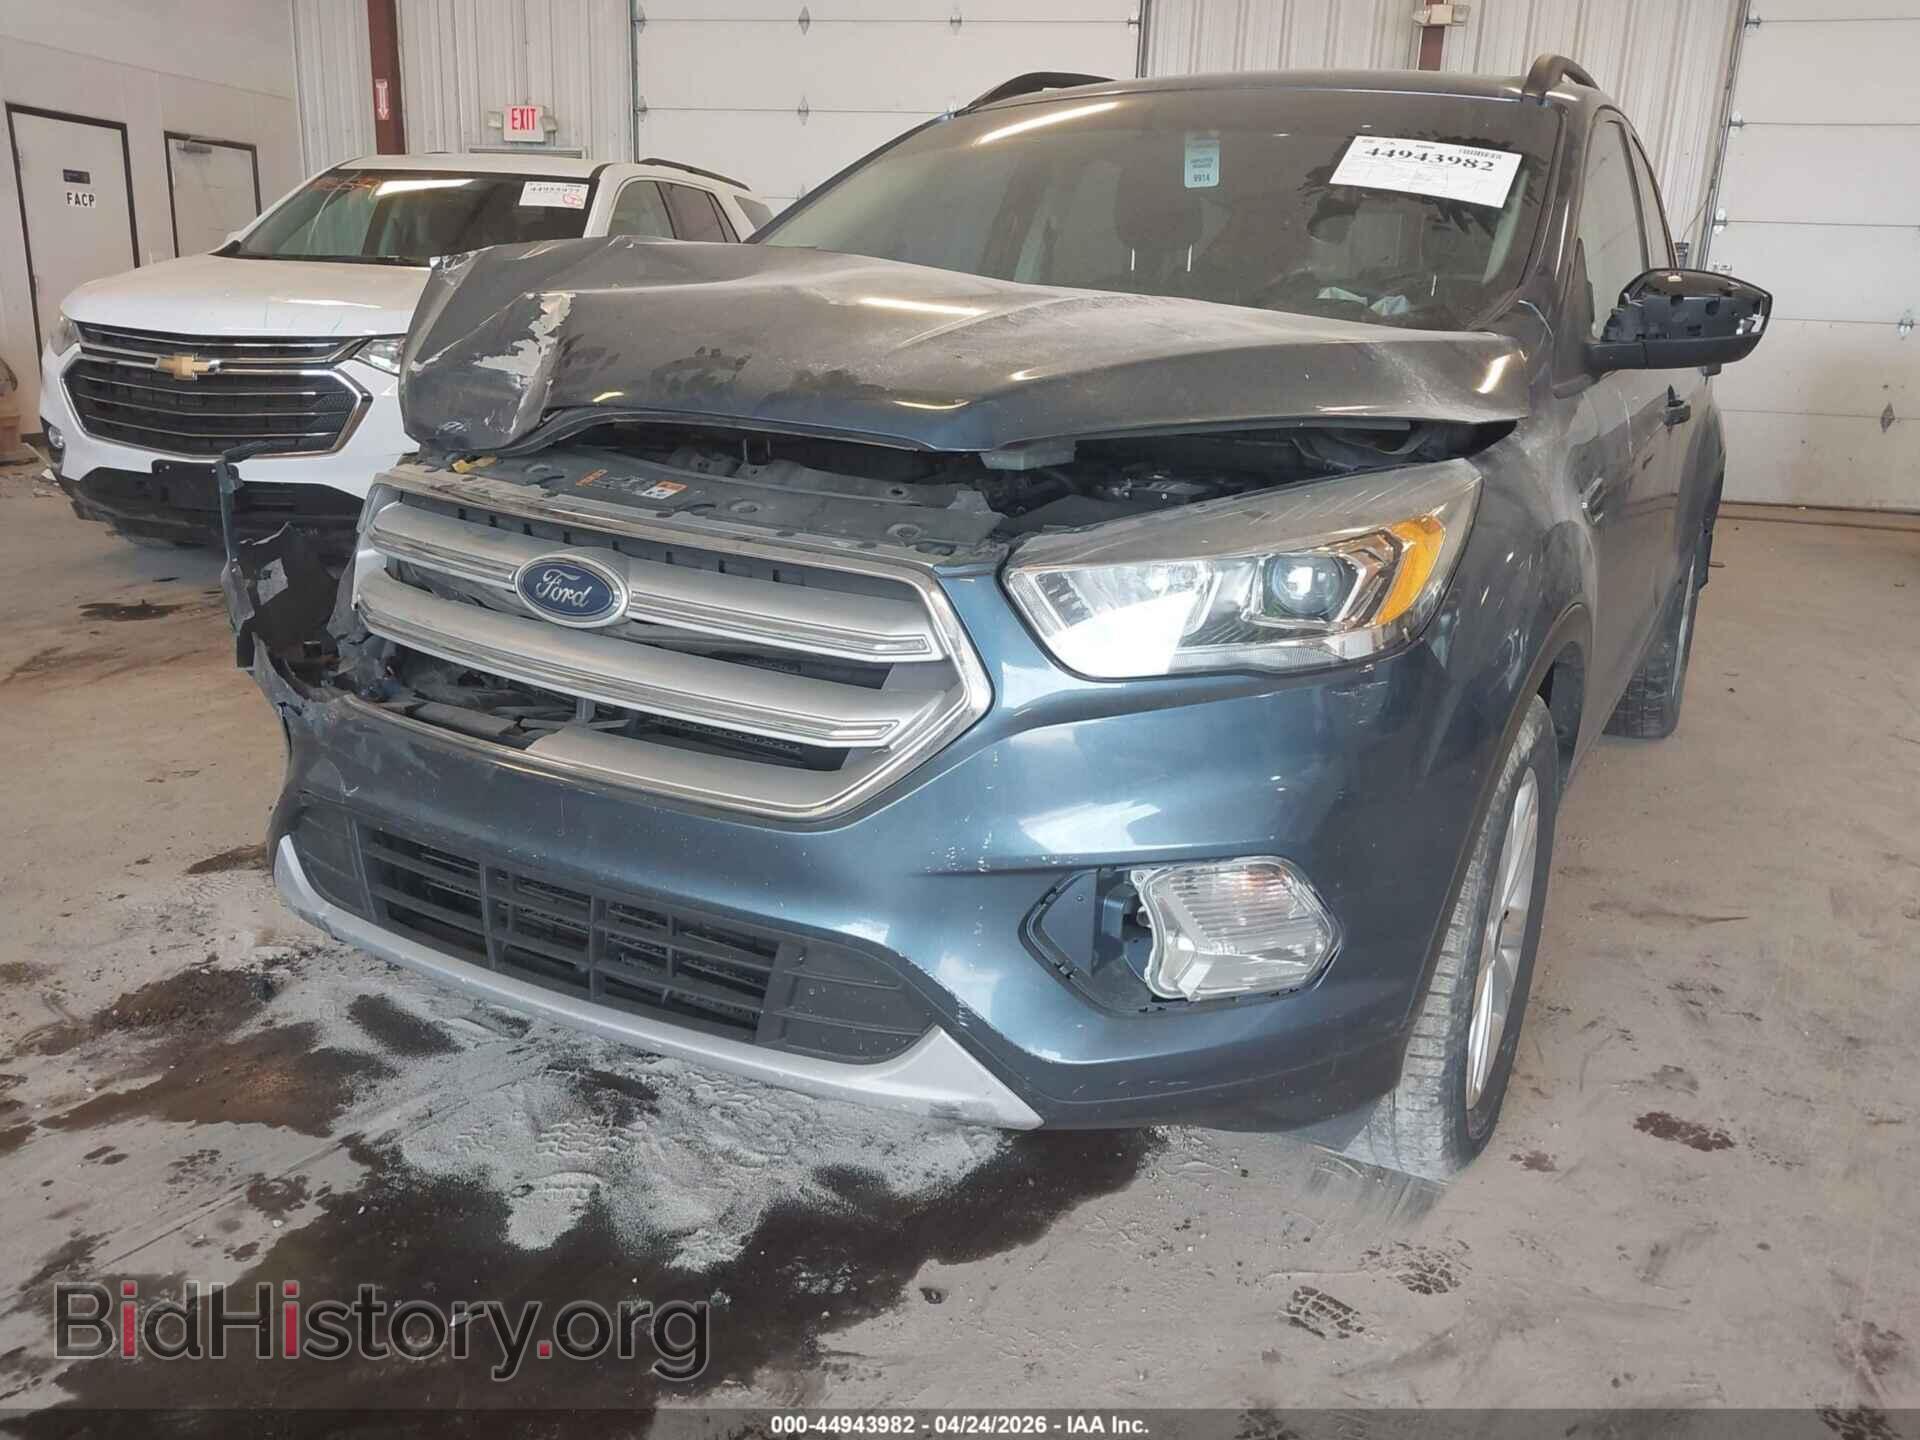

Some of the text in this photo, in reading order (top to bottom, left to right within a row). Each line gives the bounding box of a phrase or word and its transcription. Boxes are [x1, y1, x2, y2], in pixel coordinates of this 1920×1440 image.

[511, 107, 537, 131] EXIT
[1363, 146, 1495, 172] 44943982
[66, 191, 95, 207] FACP
[535, 568, 593, 608] Ford
